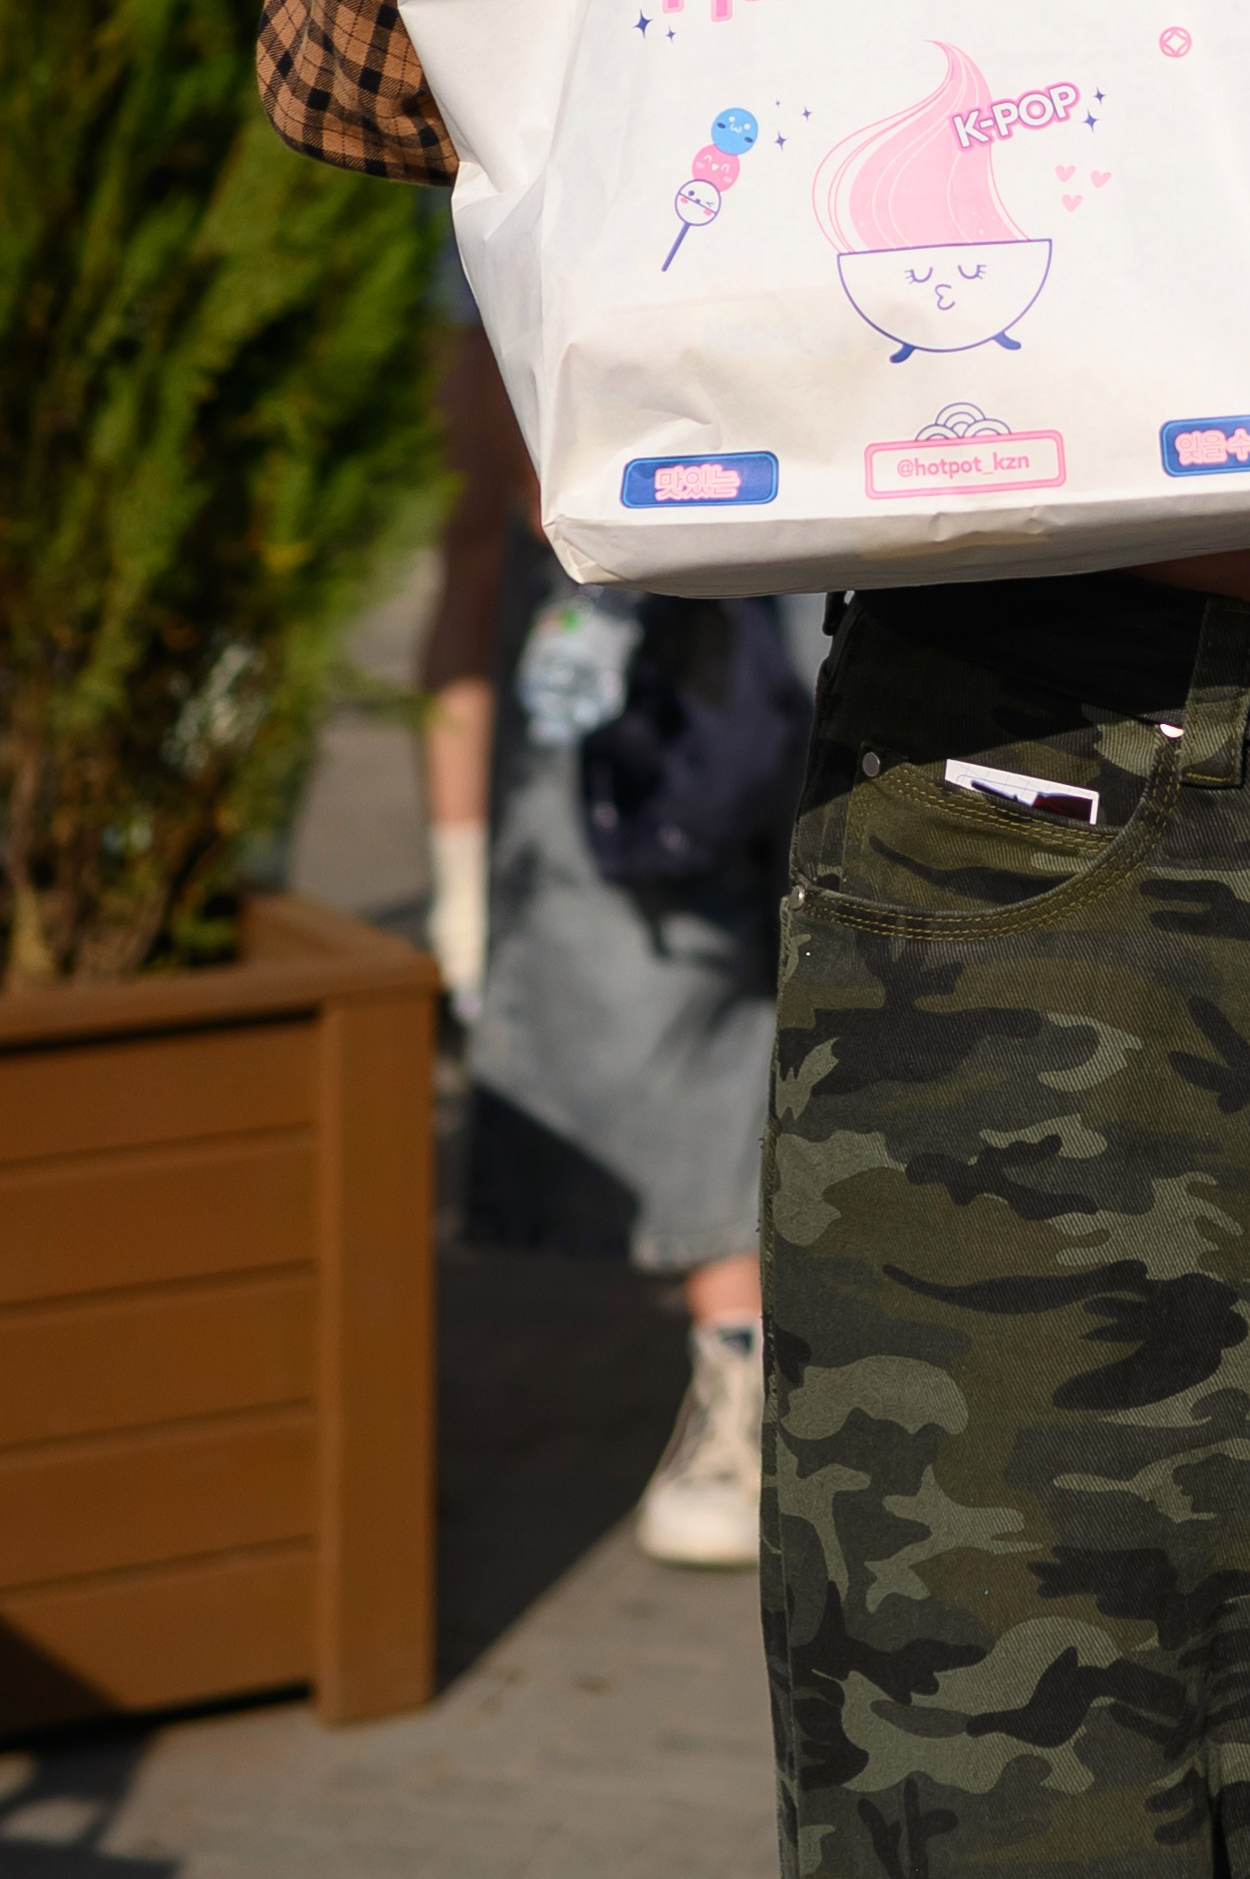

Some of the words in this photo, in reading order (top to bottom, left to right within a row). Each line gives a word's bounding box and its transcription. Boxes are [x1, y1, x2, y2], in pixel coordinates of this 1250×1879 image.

[952, 82, 1080, 152] K-POP
[654, 463, 741, 501] 맛있는
[896, 451, 1030, 480] @hotpot_kzn
